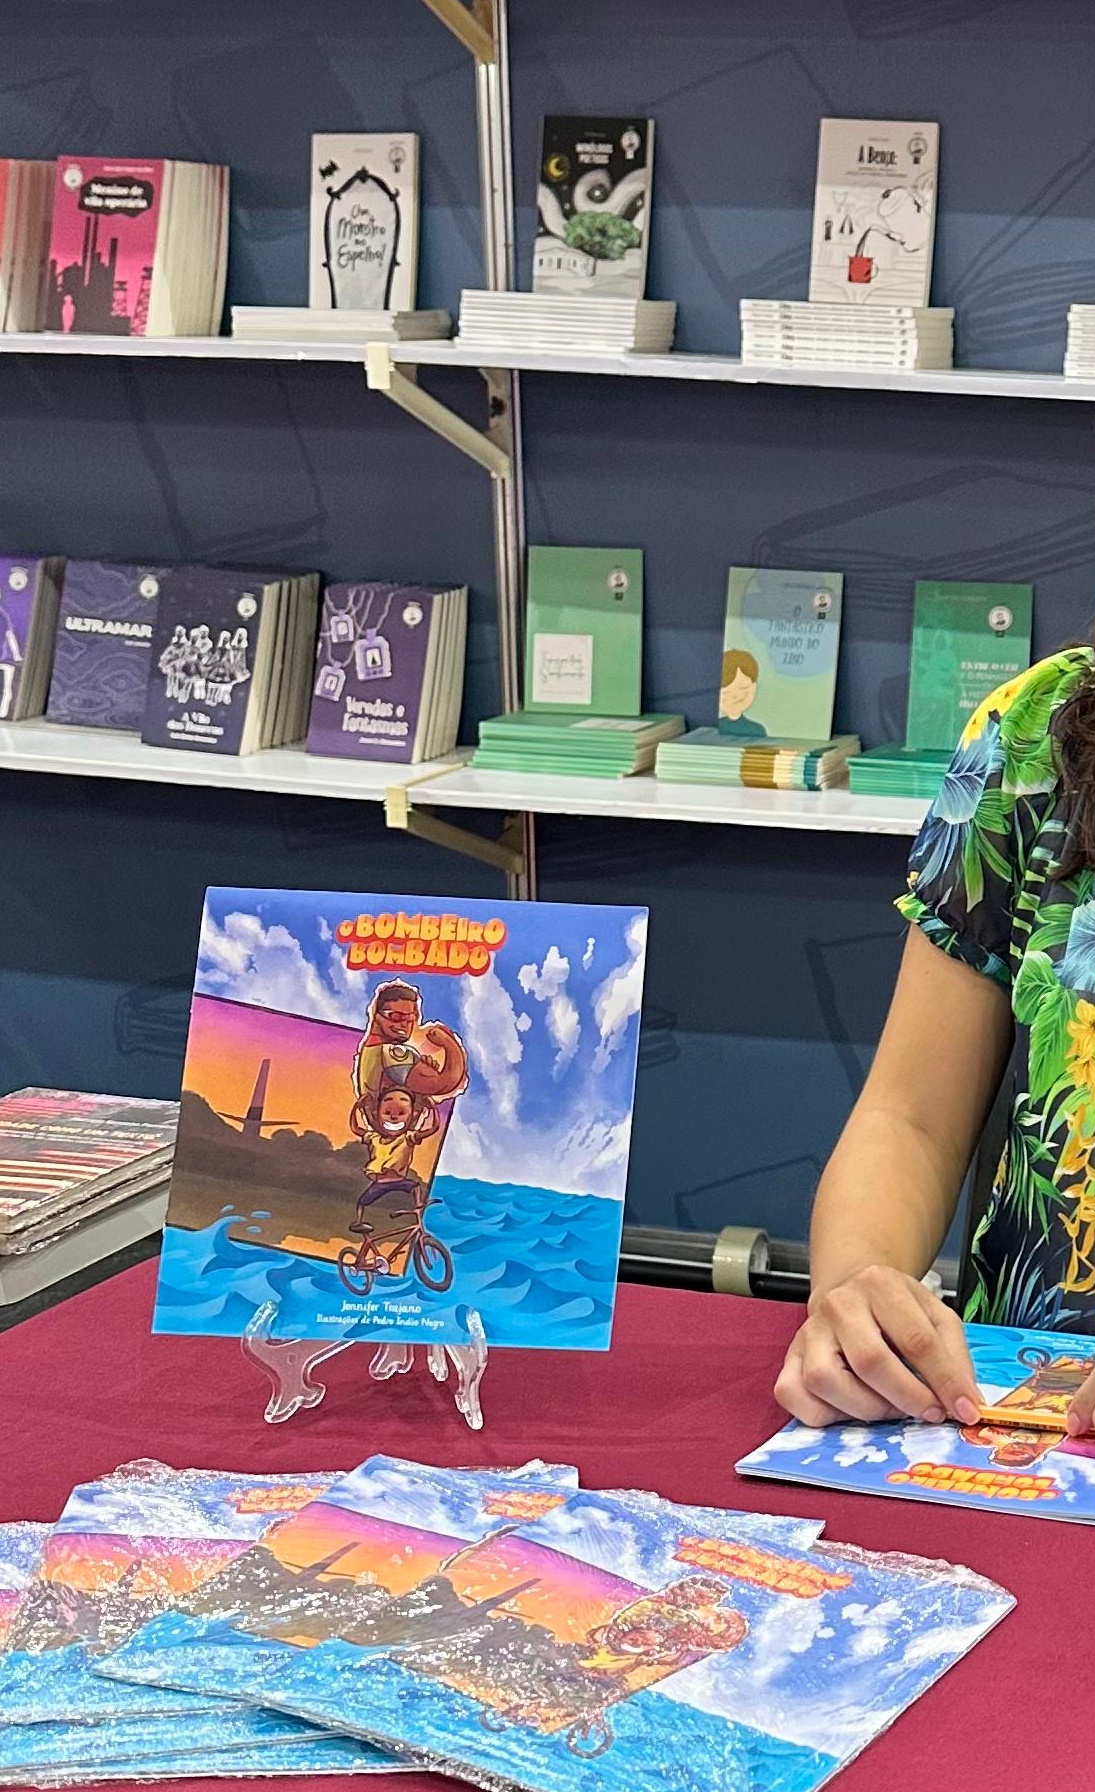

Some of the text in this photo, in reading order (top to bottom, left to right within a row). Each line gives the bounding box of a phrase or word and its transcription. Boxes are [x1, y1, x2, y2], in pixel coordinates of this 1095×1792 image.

[65, 616, 153, 638] ULTRAMAR
[355, 912, 506, 945] BOMBEIRO
[350, 939, 489, 970] BOMBADO
[341, 1300, 422, 1315] Jennifer Trajano
[372, 1315, 394, 1325] Pedro
[421, 1317, 445, 1331] Negro
